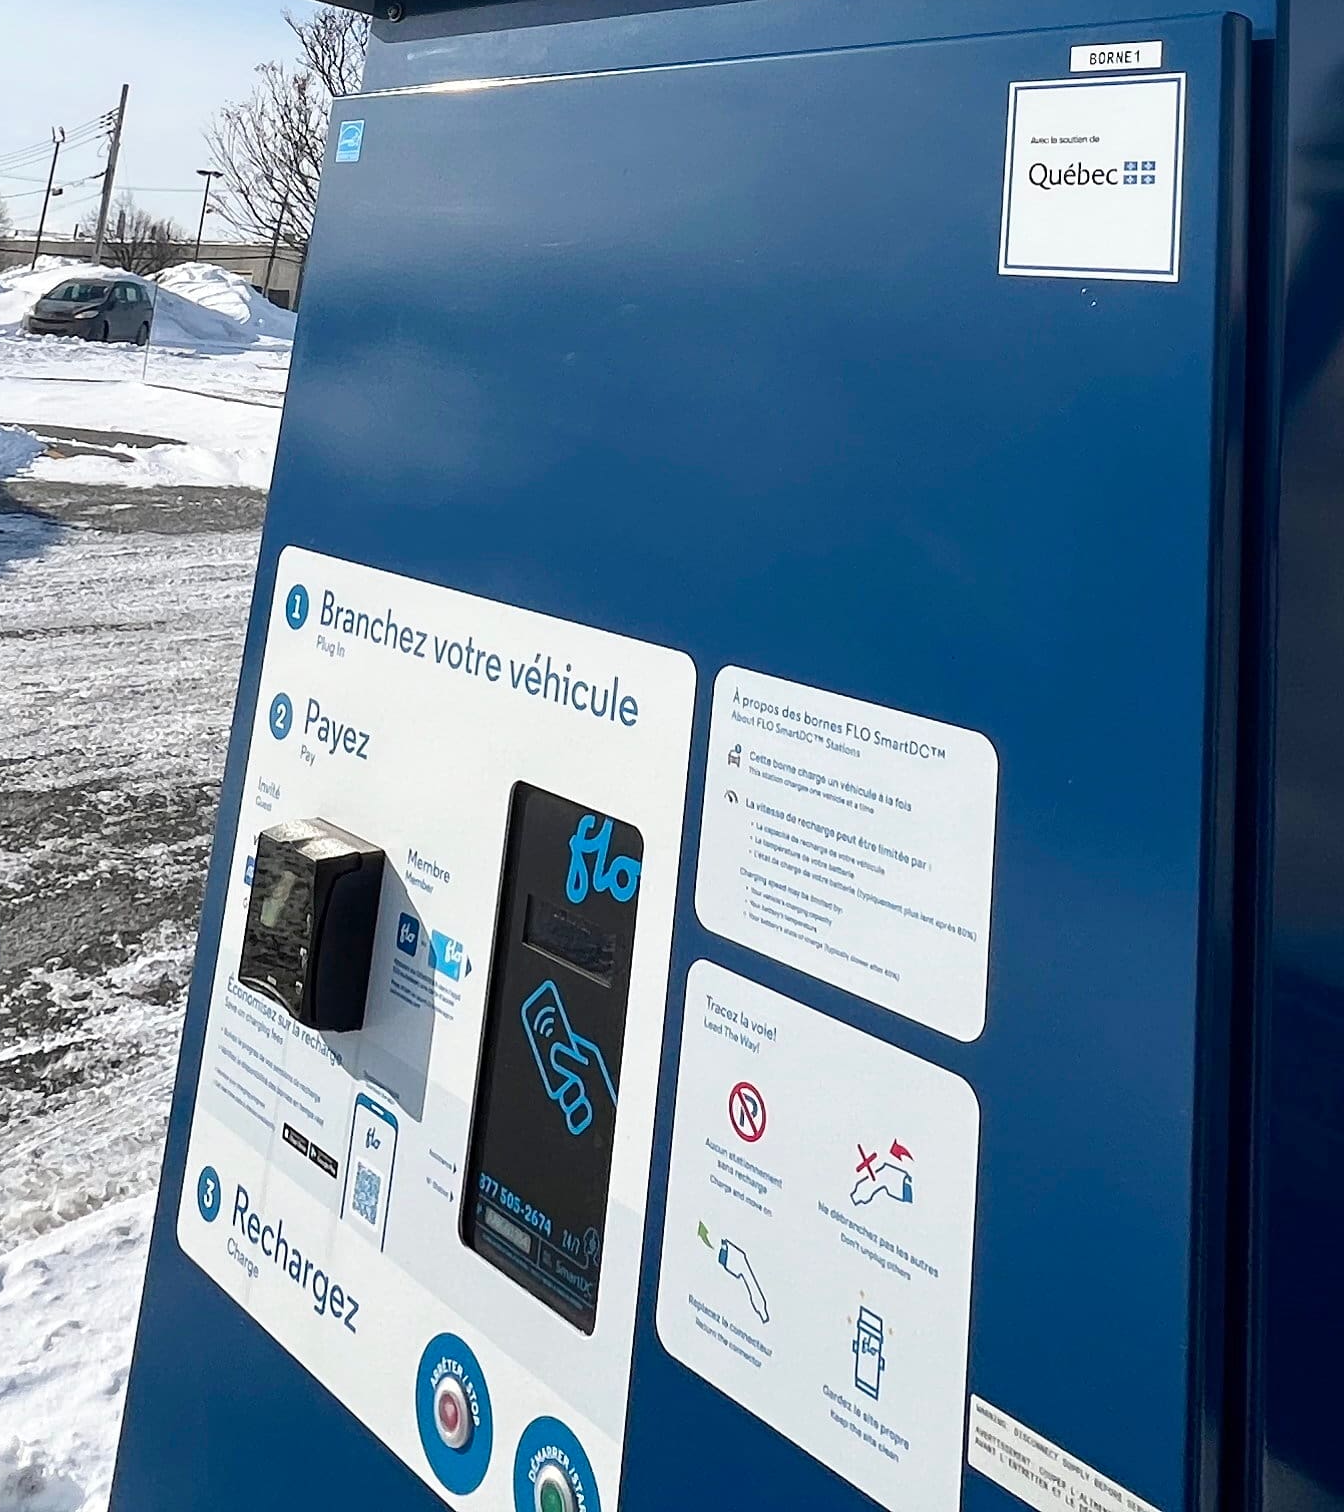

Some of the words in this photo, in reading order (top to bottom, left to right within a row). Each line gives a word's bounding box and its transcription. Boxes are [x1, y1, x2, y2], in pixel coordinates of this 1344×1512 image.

[1059, 135, 1087, 144] soutien
[1089, 135, 1100, 143] de
[1028, 161, 1119, 190] Québec
[316, 634, 337, 657] Plug
[337, 642, 346, 658] In
[320, 589, 428, 659] Branchez
[434, 636, 502, 682] votre
[509, 653, 639, 727] véhicule
[304, 697, 371, 760] Payez
[732, 709, 755, 727] About
[757, 717, 774, 732] FLO
[825, 738, 861, 758] Stations
[742, 696, 779, 717] propos
[782, 705, 801, 723] des
[804, 711, 843, 734] bornes
[846, 723, 871, 742] FLO
[299, 744, 316, 767] Pay
[257, 776, 281, 800] Invité
[749, 750, 771, 767] Cette
[773, 758, 796, 775] borne
[797, 768, 826, 786] charge
[827, 778, 839, 788] un
[840, 781, 877, 801] véhicule
[885, 794, 894, 806] la
[895, 797, 912, 812] fois
[566, 813, 641, 904] flo
[746, 797, 755, 810] La
[756, 803, 785, 820] vitesse
[786, 812, 797, 824] de
[797, 817, 835, 838] recharge
[836, 831, 857, 845] peut
[858, 836, 877, 853] être
[878, 843, 910, 865] limitée
[911, 856, 927, 870] par
[405, 870, 434, 895] Member
[407, 847, 451, 884] Membre
[227, 971, 277, 1022] Économisez
[277, 1012, 292, 1032] sur
[291, 1020, 300, 1037] la
[301, 1029, 343, 1067] recharge
[704, 1015, 723, 1035] Lead
[724, 1025, 739, 1043] The
[706, 994, 738, 1024] Tracez
[740, 1011, 749, 1029] la
[751, 1020, 777, 1044] voie!
[705, 1137, 728, 1158] Aucun
[728, 1152, 783, 1190] stationnement
[709, 1173, 732, 1194] Charge
[717, 1159, 734, 1176] sans
[734, 1169, 768, 1195] recharge
[499, 1186, 553, 1238] 505-2674
[226, 1236, 260, 1280] Charge
[231, 1183, 361, 1335] Rechargez
[818, 1199, 829, 1215] Ne
[830, 1209, 878, 1244] débranchez
[879, 1237, 895, 1253] pas
[896, 1244, 909, 1261] les
[910, 1255, 939, 1278] autres
[860, 1245, 886, 1269] unplug
[689, 1293, 721, 1324] Replacez
[721, 1316, 729, 1329] le
[729, 1323, 773, 1357] connecteur
[430, 1356, 464, 1389] ARRÊTER
[466, 1381, 481, 1427] STOP
[823, 1384, 853, 1412] Gardez
[853, 1404, 862, 1418] le
[863, 1412, 879, 1430] site
[880, 1424, 910, 1451] propre
[528, 1445, 570, 1483] DÉMARRER
[571, 1472, 587, 1512] STAR
